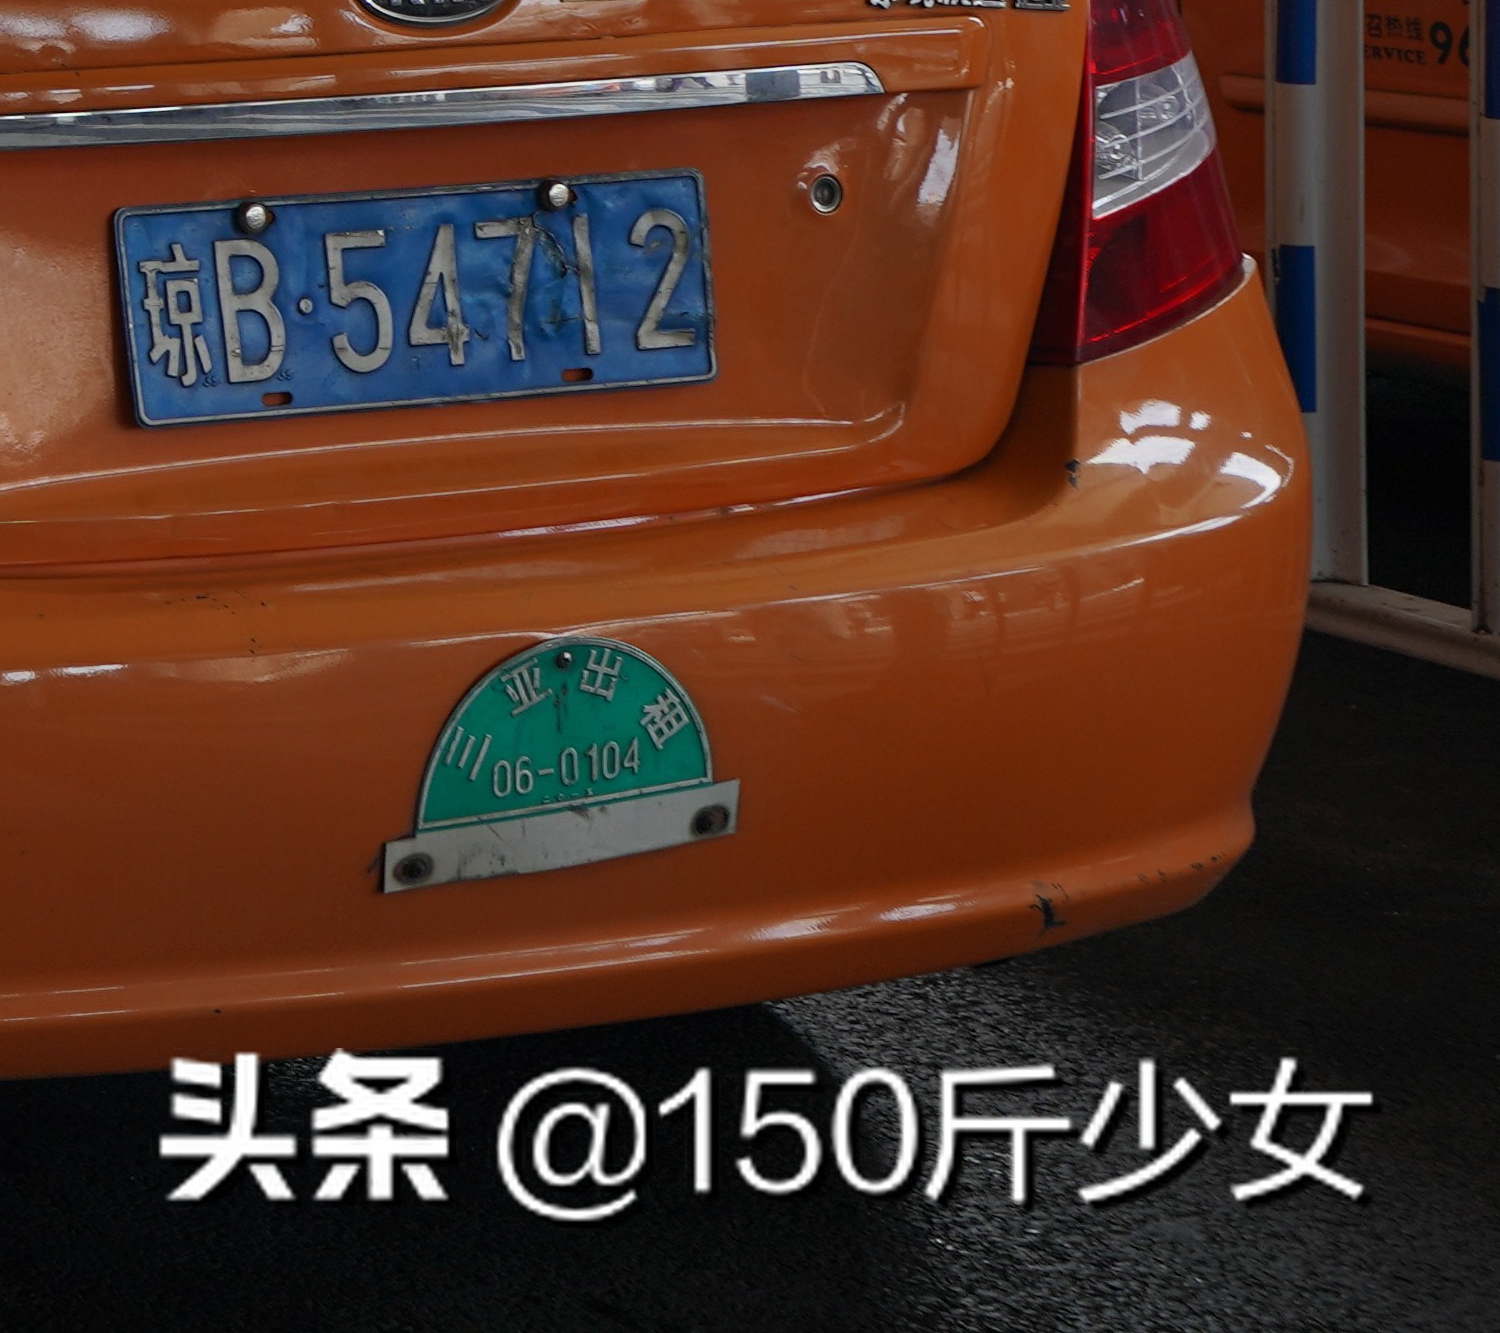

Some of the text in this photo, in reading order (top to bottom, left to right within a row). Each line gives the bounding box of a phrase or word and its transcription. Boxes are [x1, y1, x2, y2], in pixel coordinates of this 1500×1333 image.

[444, 647, 691, 782] 三亚出租
[492, 736, 641, 798] 06-0104
